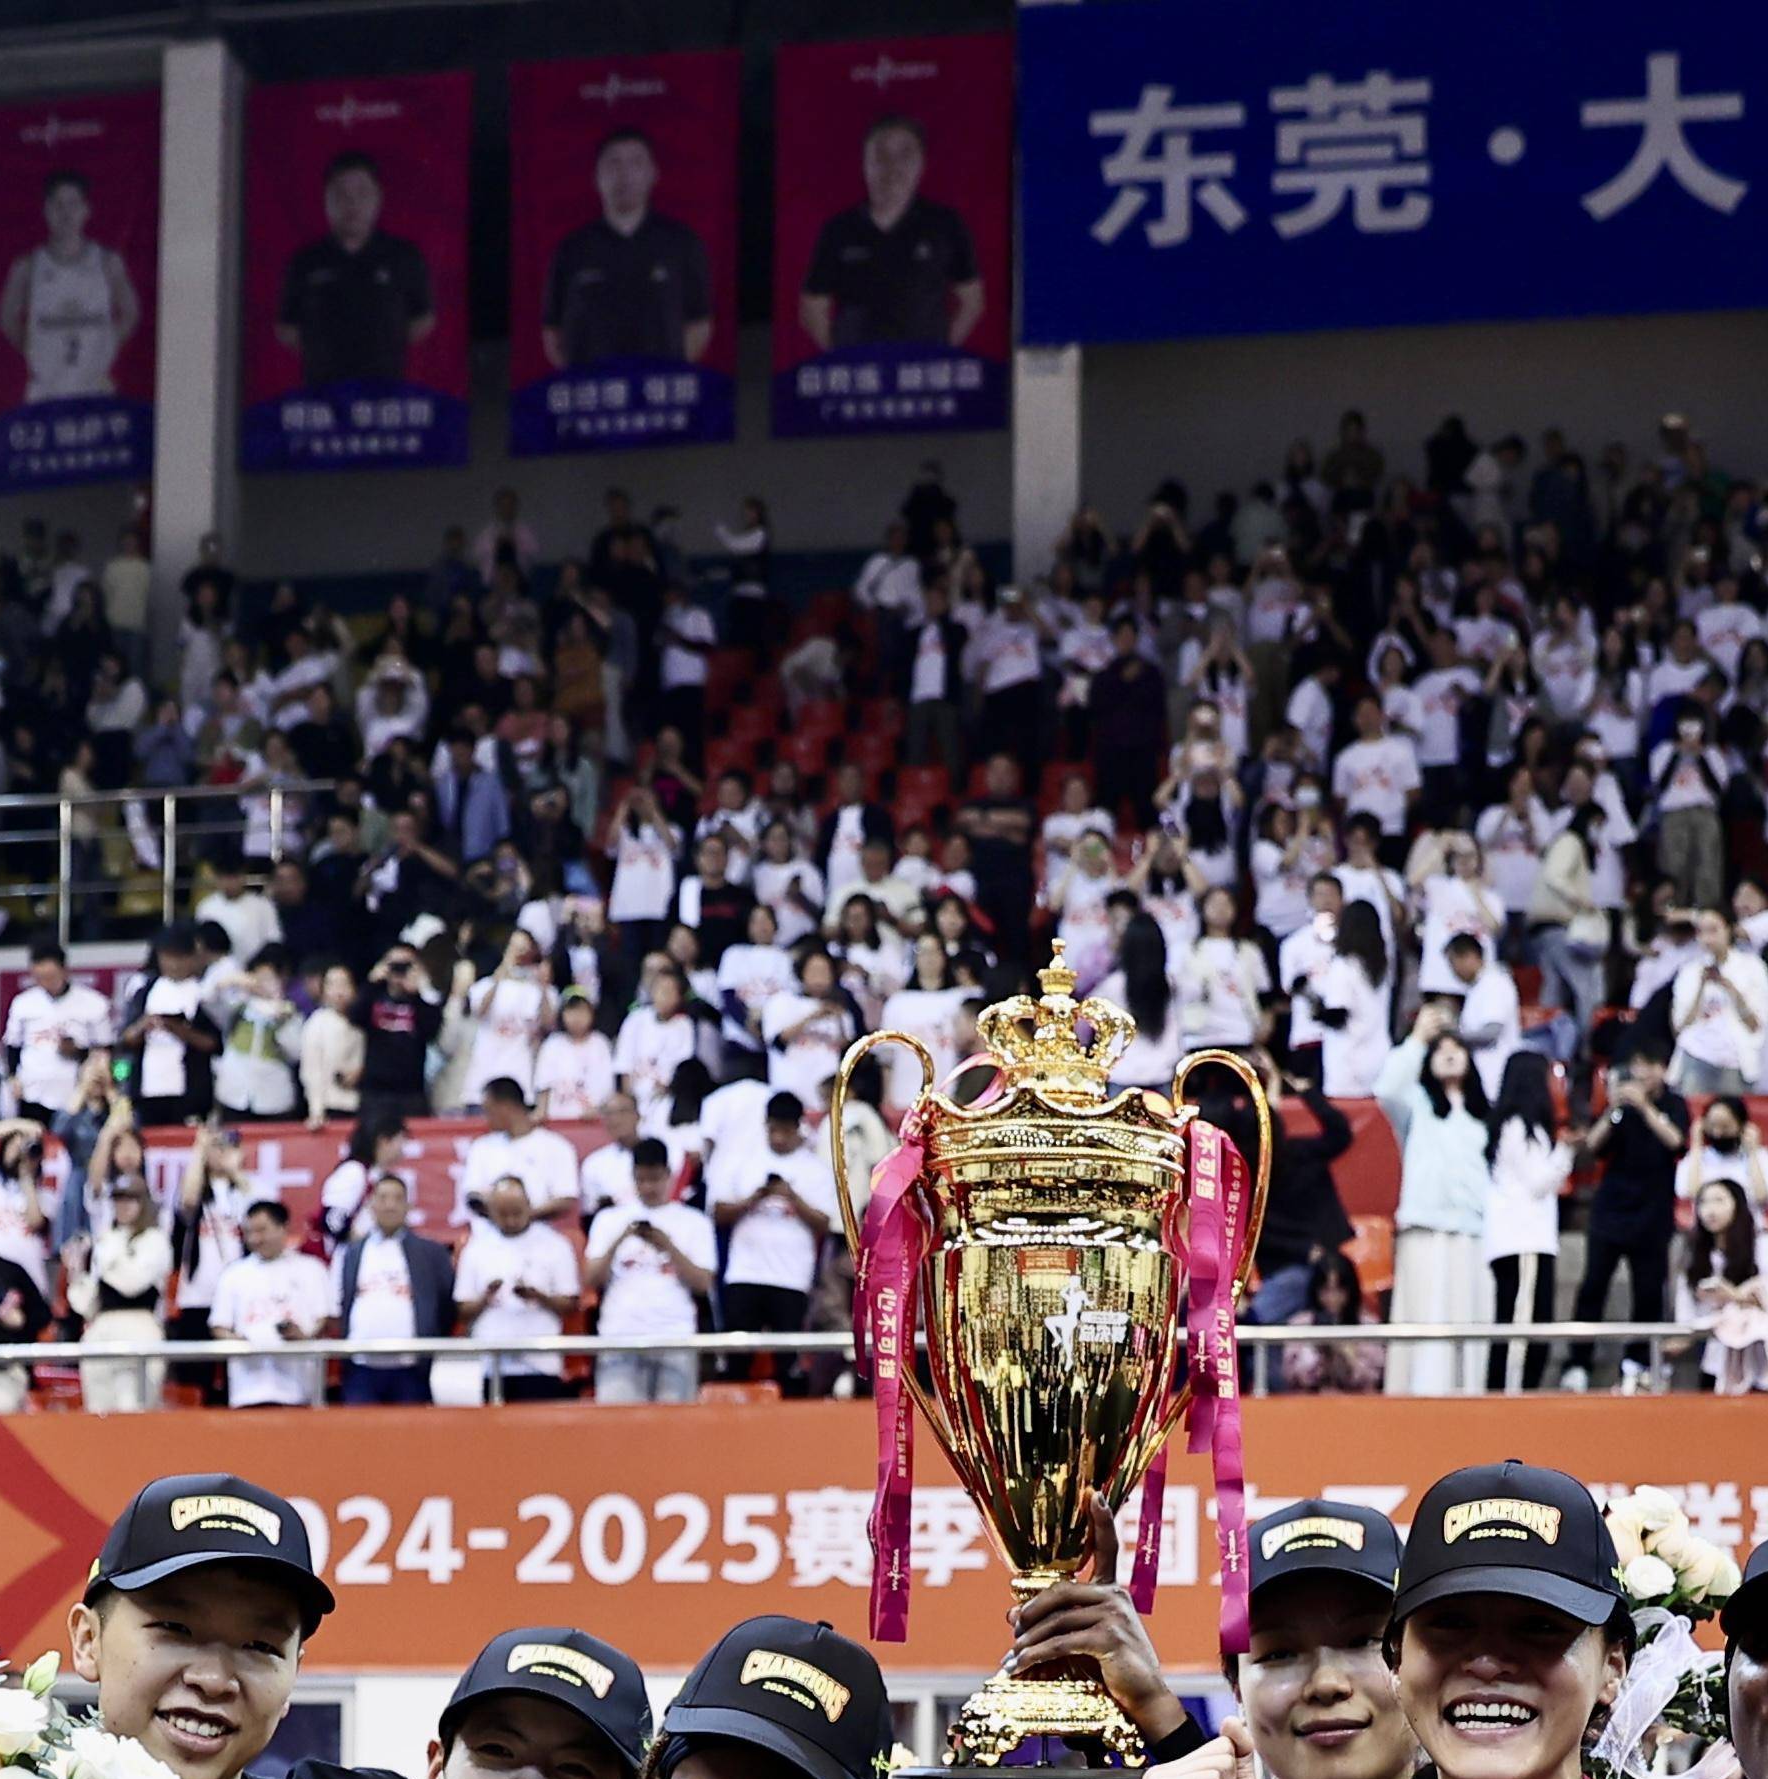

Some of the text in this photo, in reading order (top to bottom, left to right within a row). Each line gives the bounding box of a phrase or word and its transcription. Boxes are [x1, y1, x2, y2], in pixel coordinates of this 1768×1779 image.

[170, 1494, 282, 1547] CHAMPIONS
[1260, 1516, 1366, 1561] CHAMPIONS
[1443, 1497, 1562, 1546] CHAMPIONS
[506, 1643, 616, 1700] CHAMPIONS
[739, 1648, 852, 1724] CHAMPIONS
